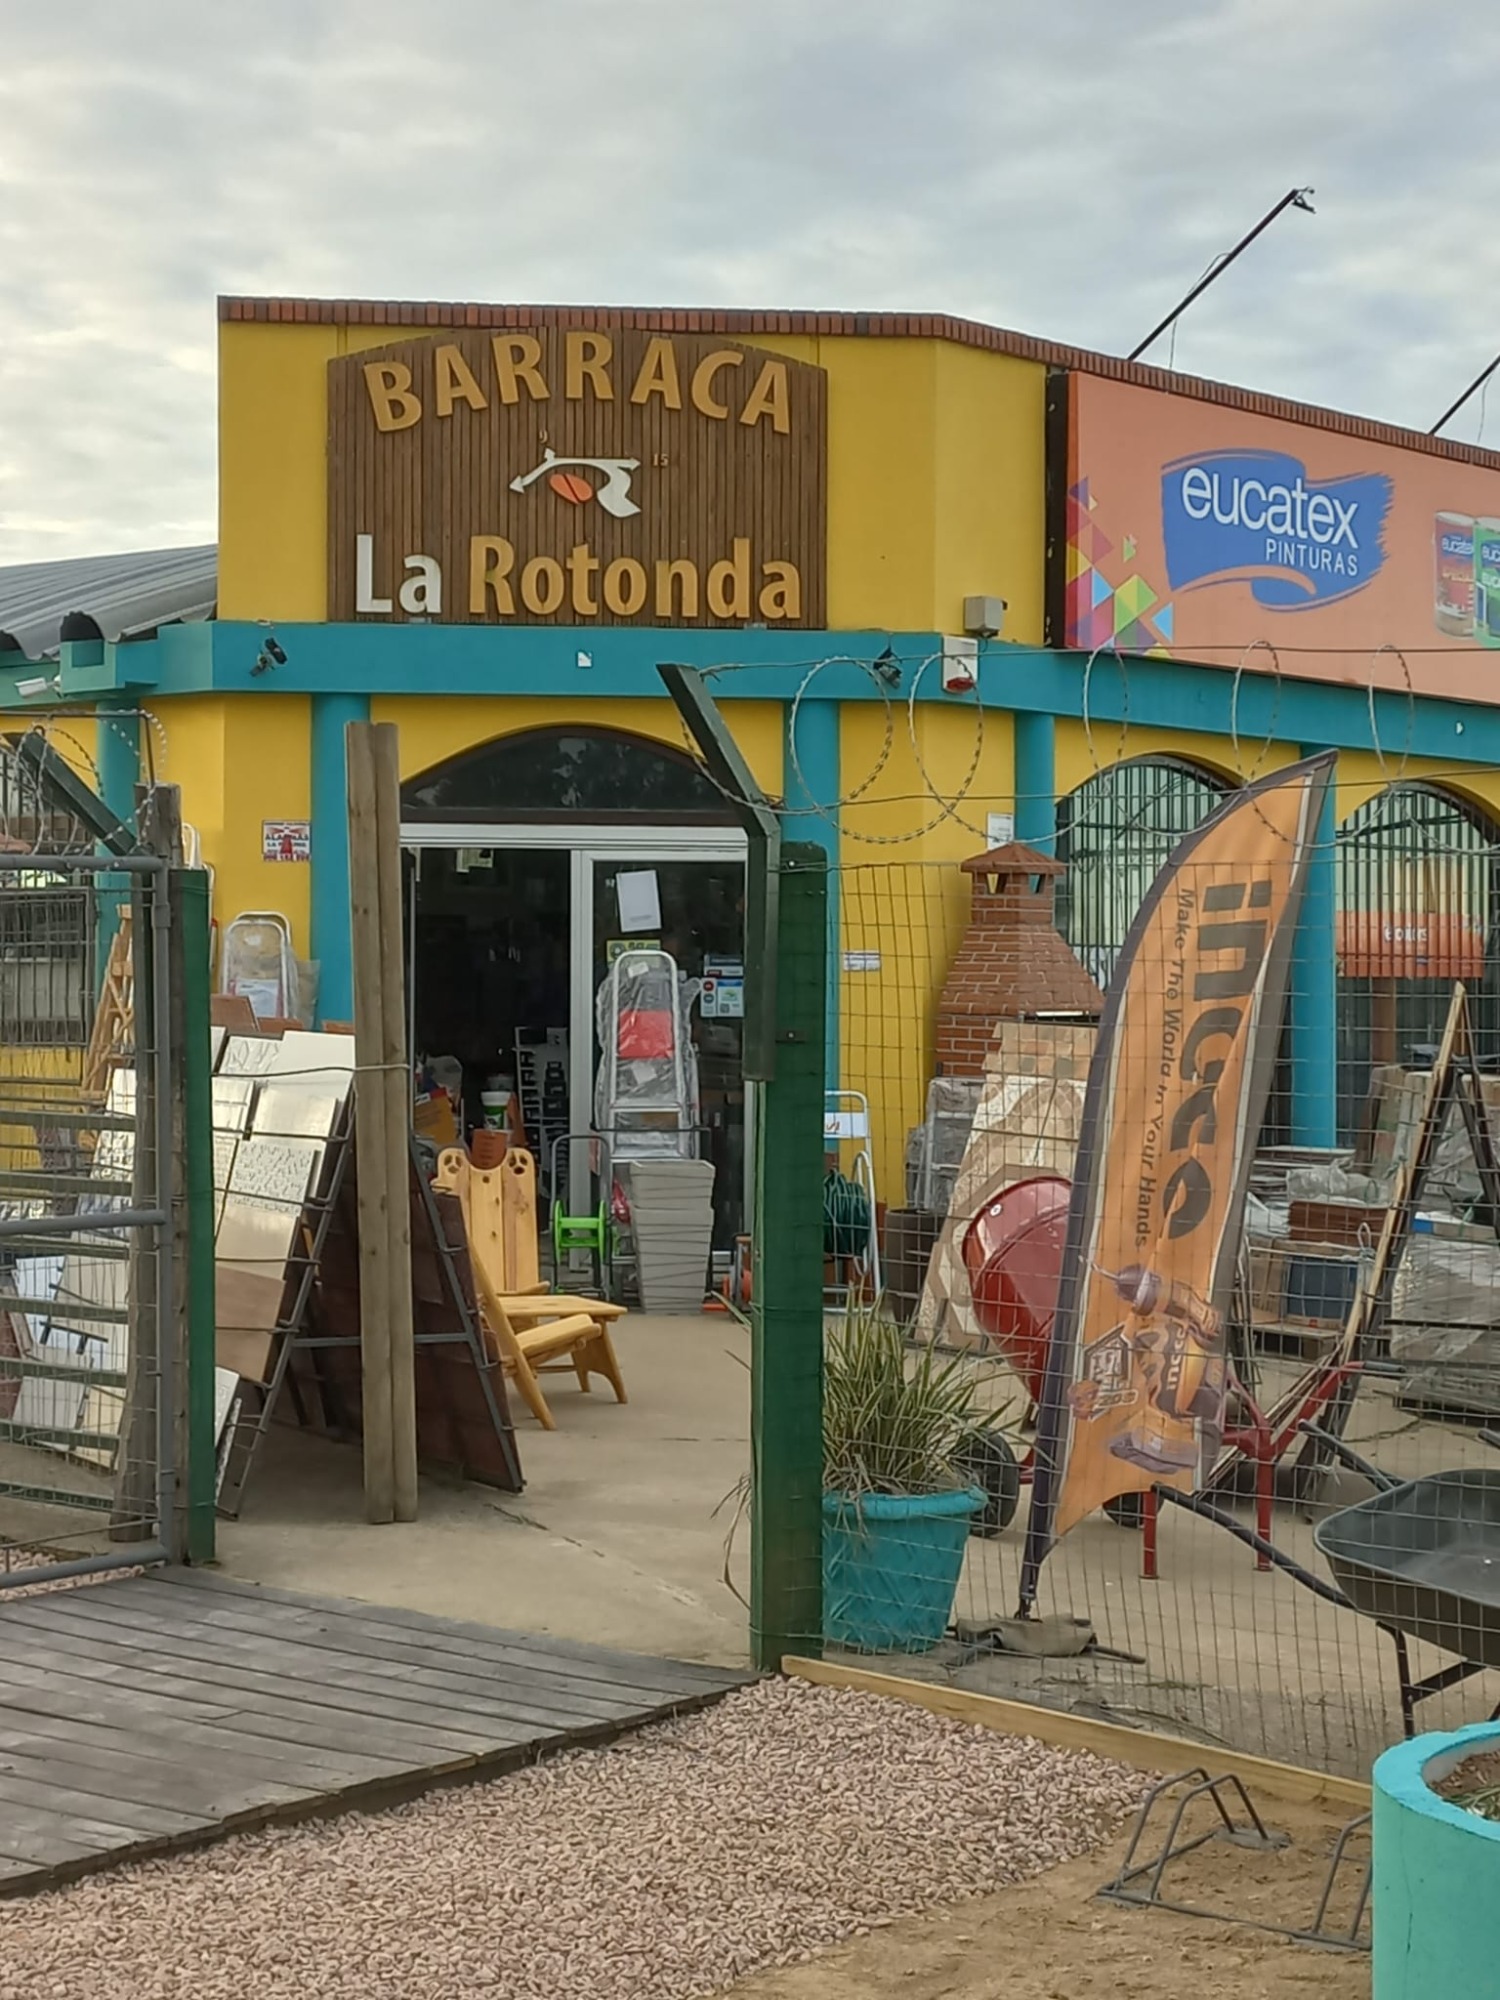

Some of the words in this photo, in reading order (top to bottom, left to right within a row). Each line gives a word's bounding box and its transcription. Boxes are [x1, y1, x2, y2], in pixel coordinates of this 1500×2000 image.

[363, 331, 790, 434] BARRACA
[653, 454, 669, 467] 15
[1182, 467, 1359, 549] eucatex
[356, 533, 441, 615] La
[469, 535, 801, 619] Rotonda
[1265, 538, 1359, 577] PINTURAS
[1174, 888, 1195, 950] Make
[1167, 960, 1185, 1000] The
[1160, 1009, 1183, 1077] World
[1141, 1113, 1164, 1170] Your
[1135, 1175, 1157, 1248] Hands
